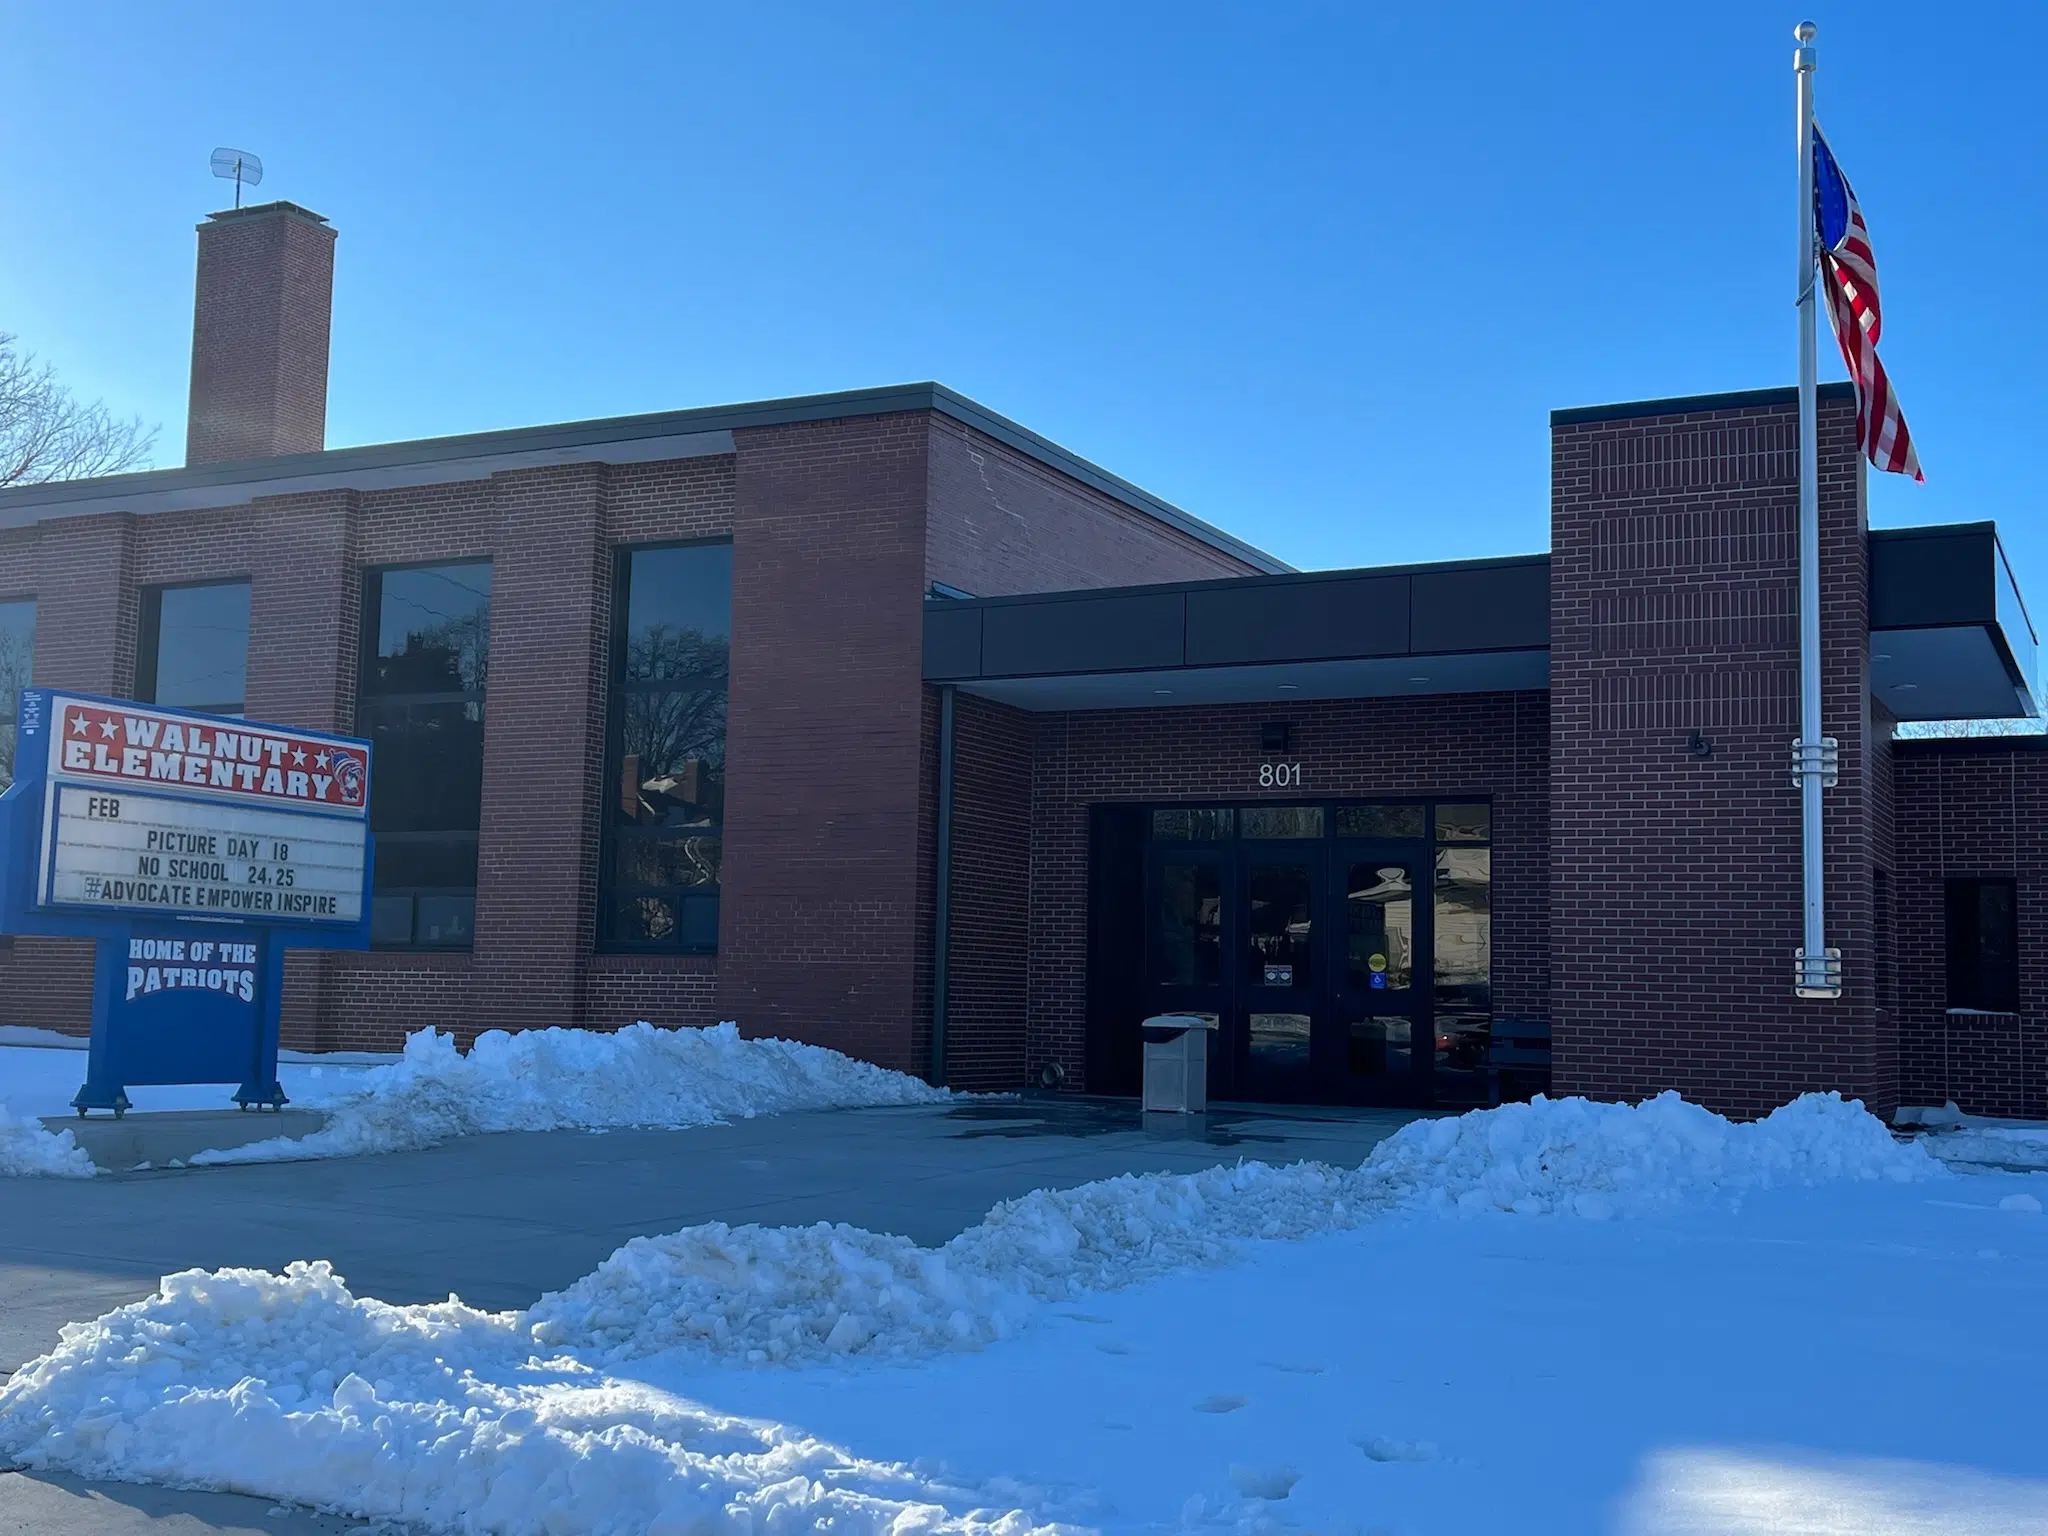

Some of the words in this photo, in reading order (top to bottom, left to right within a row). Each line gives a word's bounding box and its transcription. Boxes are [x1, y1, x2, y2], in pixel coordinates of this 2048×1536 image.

[123, 717, 288, 766] WALNUT
[64, 739, 333, 800] ELEMENTARY
[1259, 763, 1300, 787] 801
[88, 797, 120, 818] FEB
[147, 830, 217, 855] PICTURE
[227, 838, 259, 858] DAY
[273, 842, 288, 861] 18
[138, 856, 160, 876] NO
[168, 859, 229, 882] SCHOOL
[85, 877, 191, 905] #ADVOCATE
[195, 887, 273, 911] EMPOWER
[277, 892, 337, 914] INSPIRE
[128, 938, 185, 961] HOME
[190, 941, 214, 962] OF
[219, 943, 256, 964] THE
[125, 966, 254, 1003] PATRIOTS
